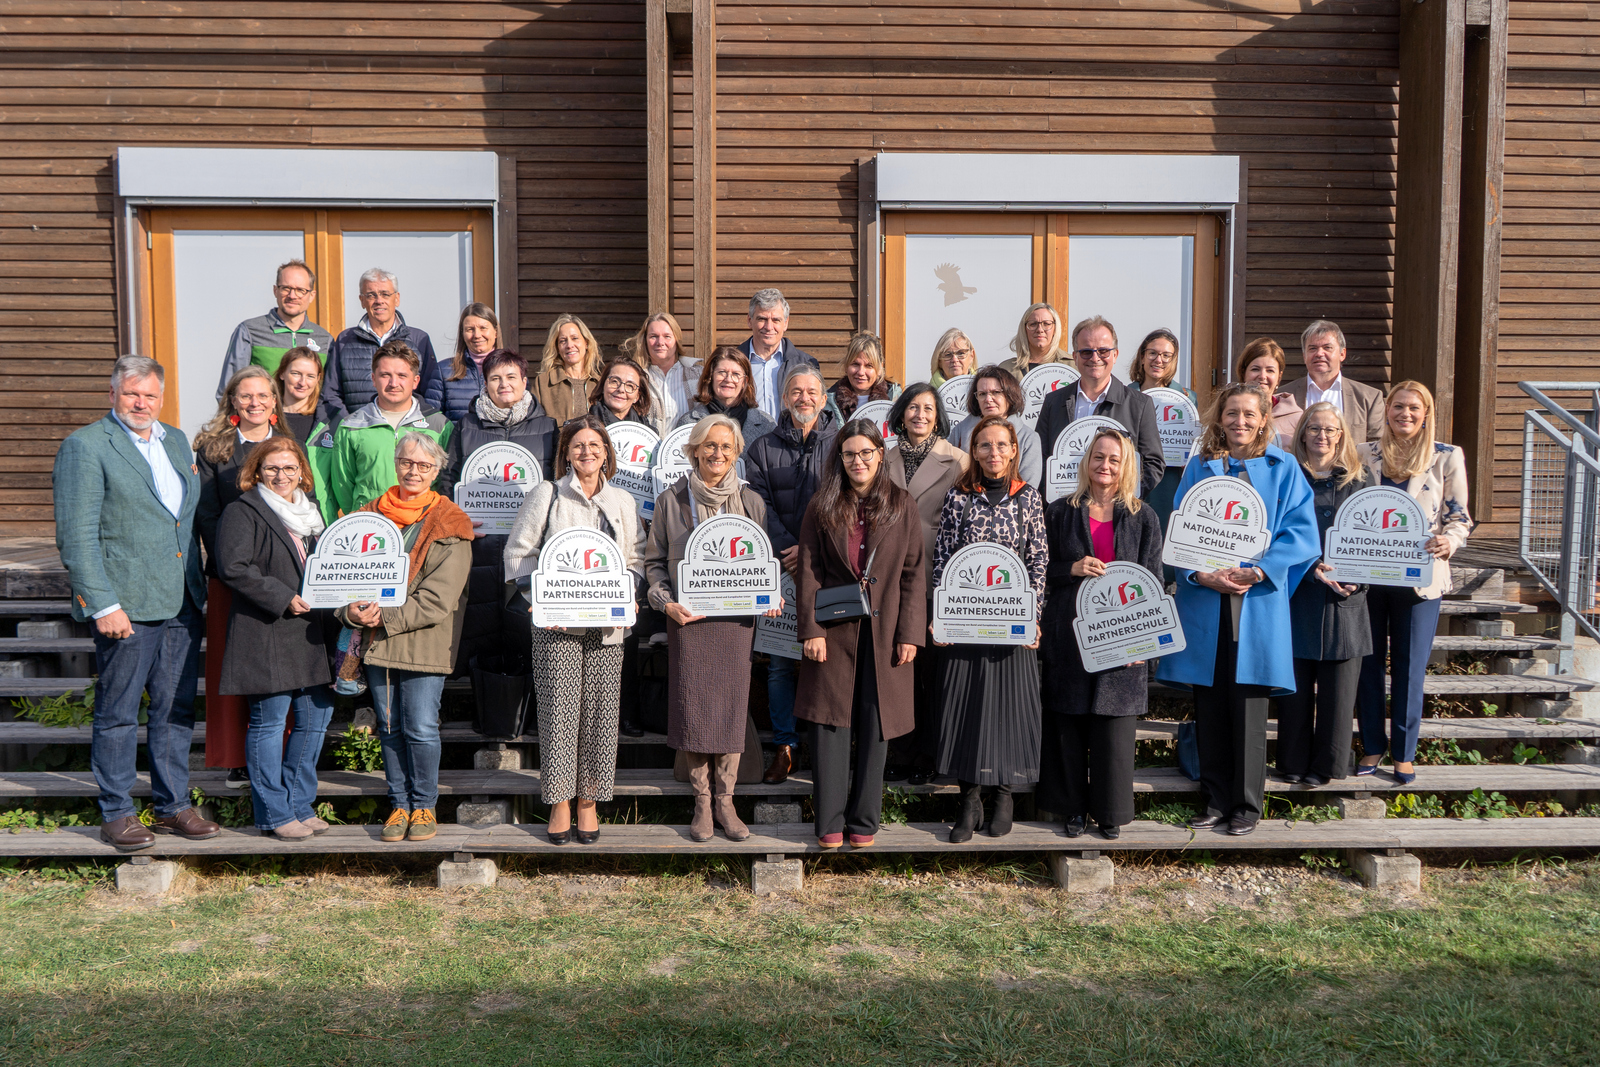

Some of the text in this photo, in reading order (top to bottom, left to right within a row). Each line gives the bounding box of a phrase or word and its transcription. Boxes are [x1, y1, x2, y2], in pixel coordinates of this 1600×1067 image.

[616, 468, 652, 483] ONALPAR
[609, 477, 654, 494] NERSCHUL
[1183, 522, 1256, 543] NATIONALPARK
[1199, 536, 1236, 550] SCHULE
[1341, 537, 1419, 548] NATIONALPARK
[1336, 547, 1422, 559] PARTNERSCHULE
[321, 562, 395, 570] NATIONALPARK
[693, 568, 766, 576] NATIONALPARK
[689, 579, 770, 588] PARTNERSCHULE
[948, 596, 1022, 604] NATIONALPARK
[945, 607, 1026, 616] PARTNERSCHULE
[1088, 607, 1162, 631] NATIONALPARK
[1088, 617, 1169, 643] PARTNERSCHULE
